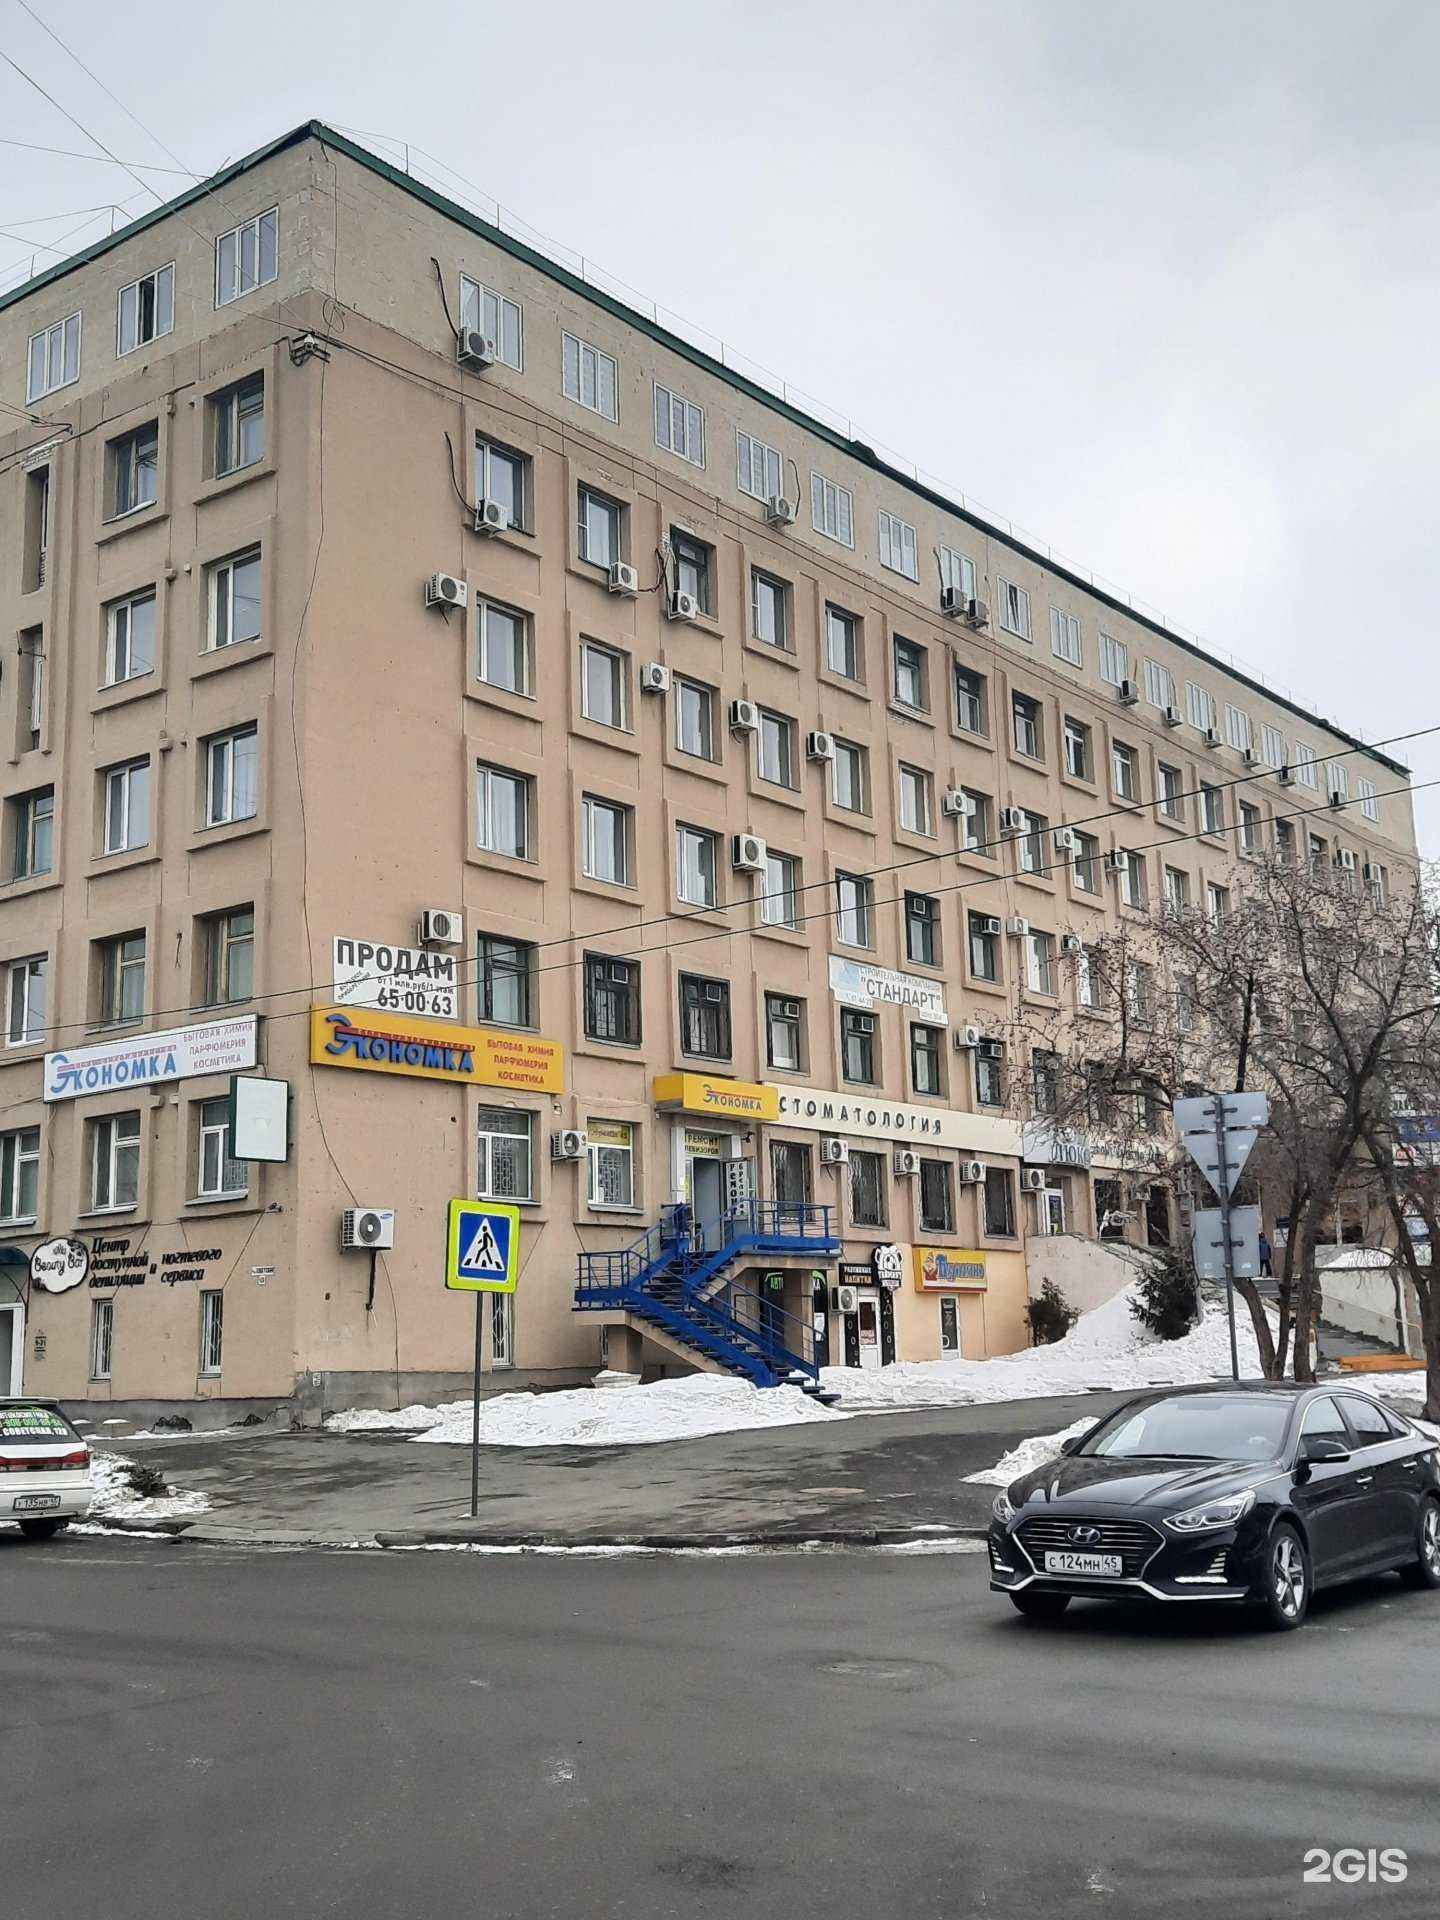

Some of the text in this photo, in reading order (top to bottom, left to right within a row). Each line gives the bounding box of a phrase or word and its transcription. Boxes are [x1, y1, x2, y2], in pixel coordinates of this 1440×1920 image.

[337, 939, 453, 981] ПРОДАМ
[183, 1021, 253, 1042] БЫТОВАЯ ХИМИЯ
[189, 1038, 246, 1056] ПАРФЮМЕРИЯ
[487, 1039, 523, 1052] БЫТОВАЯ
[527, 1045, 554, 1057] ХИМИЯ
[193, 1056, 242, 1070] КОСМЕТИКА
[494, 1054, 548, 1070] ПАРФЮМЕРИЯ
[498, 1071, 545, 1084] КОСМЕТИКА
[778, 1095, 942, 1136] СТОМАТОЛОГИЯ
[91, 1237, 130, 1255] Центр
[90, 1252, 149, 1273] доступной
[161, 1248, 222, 1265] ногтевого
[89, 1274, 146, 1289] депиляции
[160, 1268, 205, 1287] сервиса
